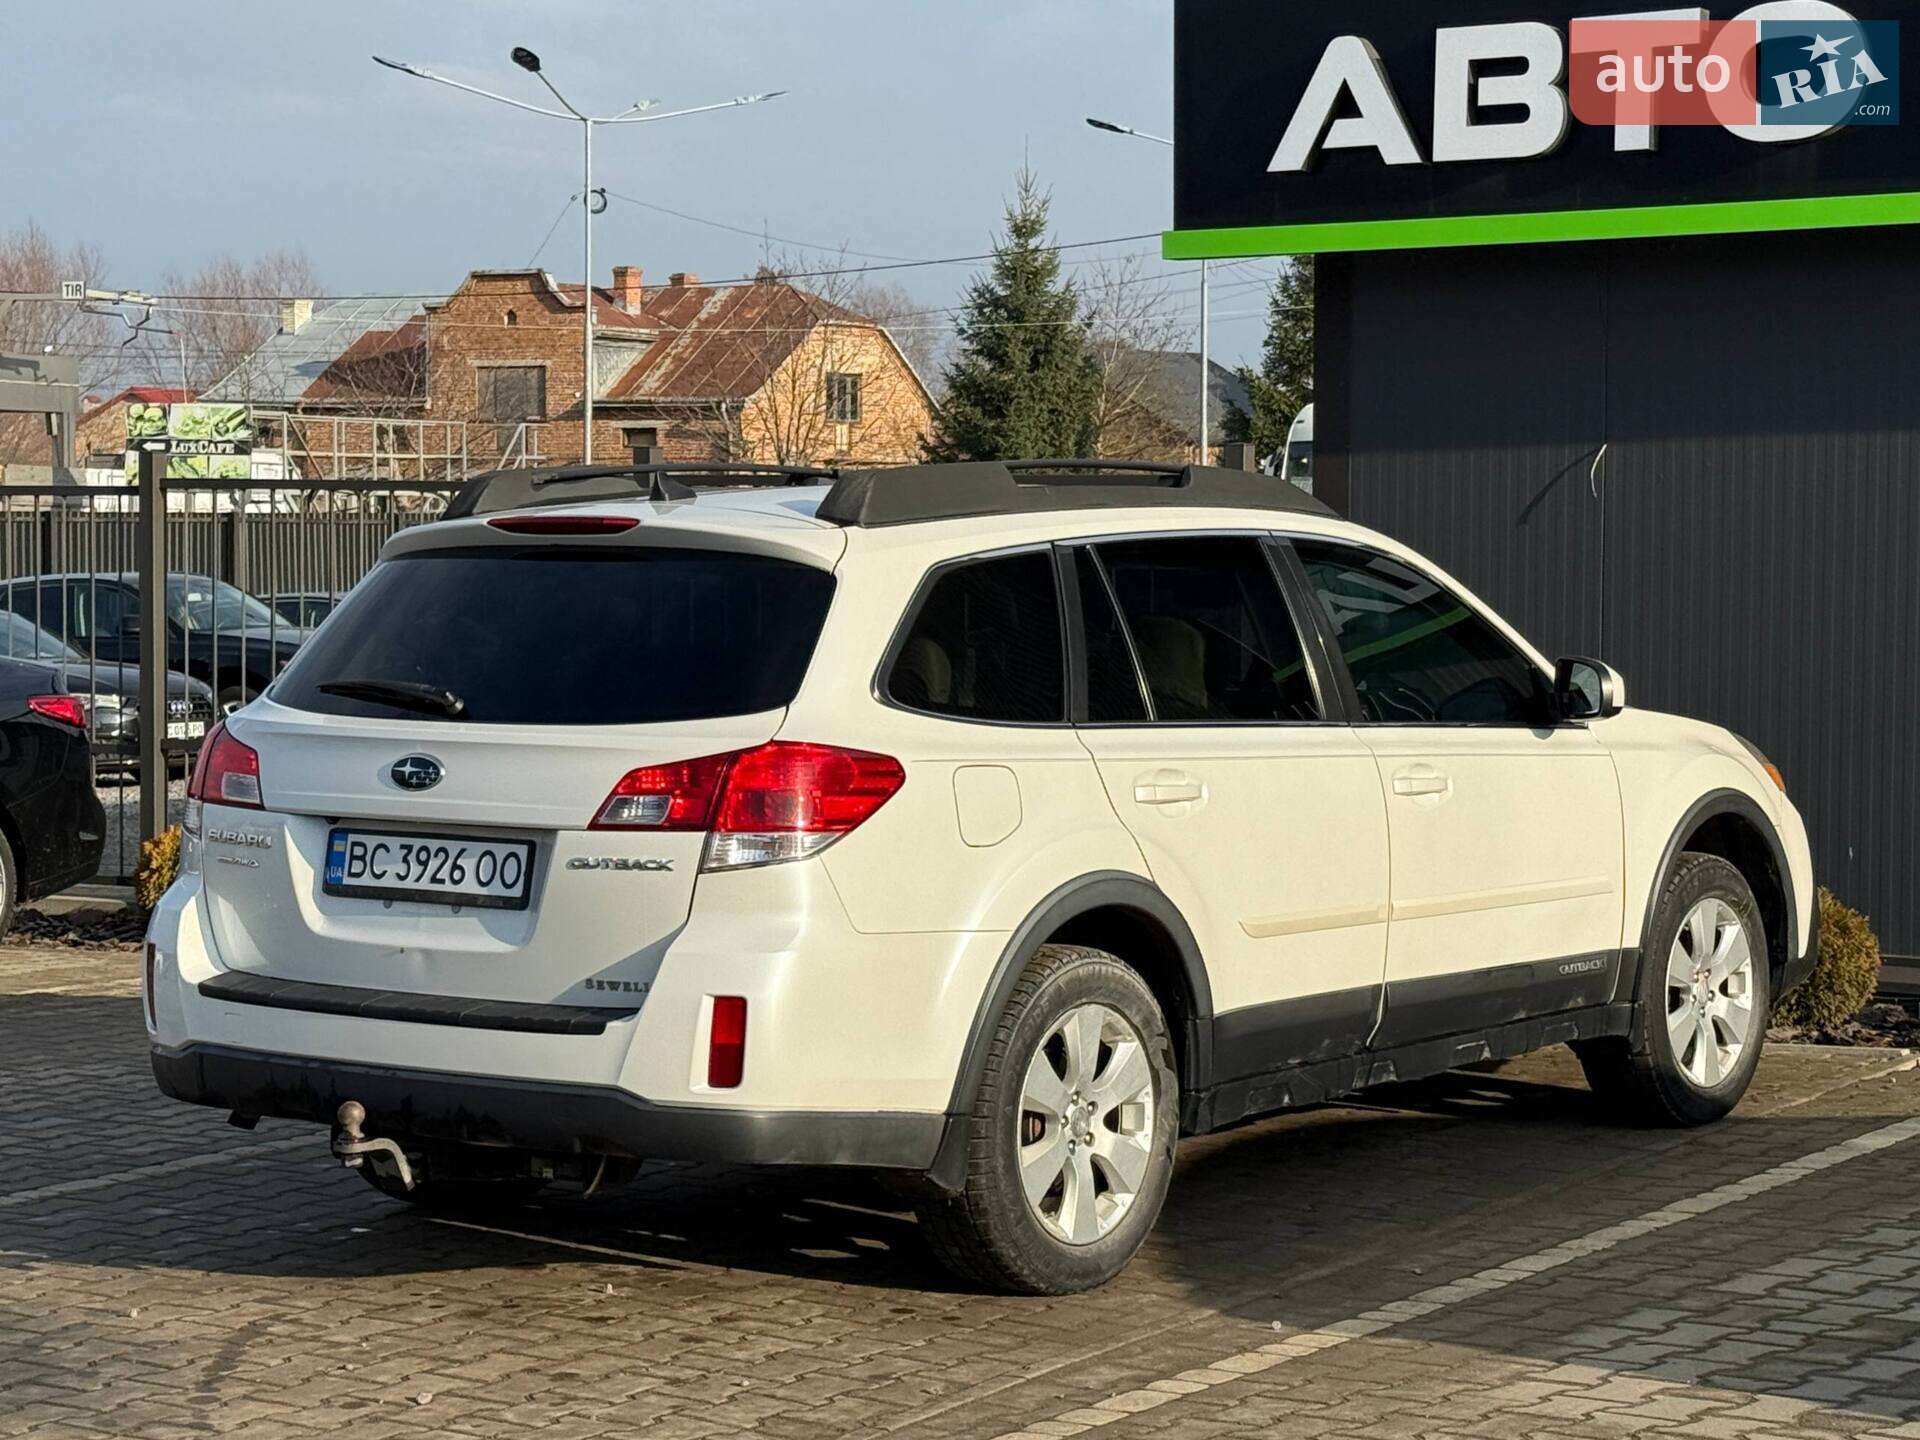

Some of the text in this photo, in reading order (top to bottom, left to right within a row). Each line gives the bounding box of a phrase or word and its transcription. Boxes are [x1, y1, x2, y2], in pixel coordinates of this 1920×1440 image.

[64, 283, 82, 297] TIR
[208, 828, 272, 848] SUBARU
[330, 865, 343, 877] UA
[347, 840, 522, 889] BC 3926 OO
[565, 856, 674, 872] OUTBACK
[1558, 956, 1608, 975] OUTBACK
